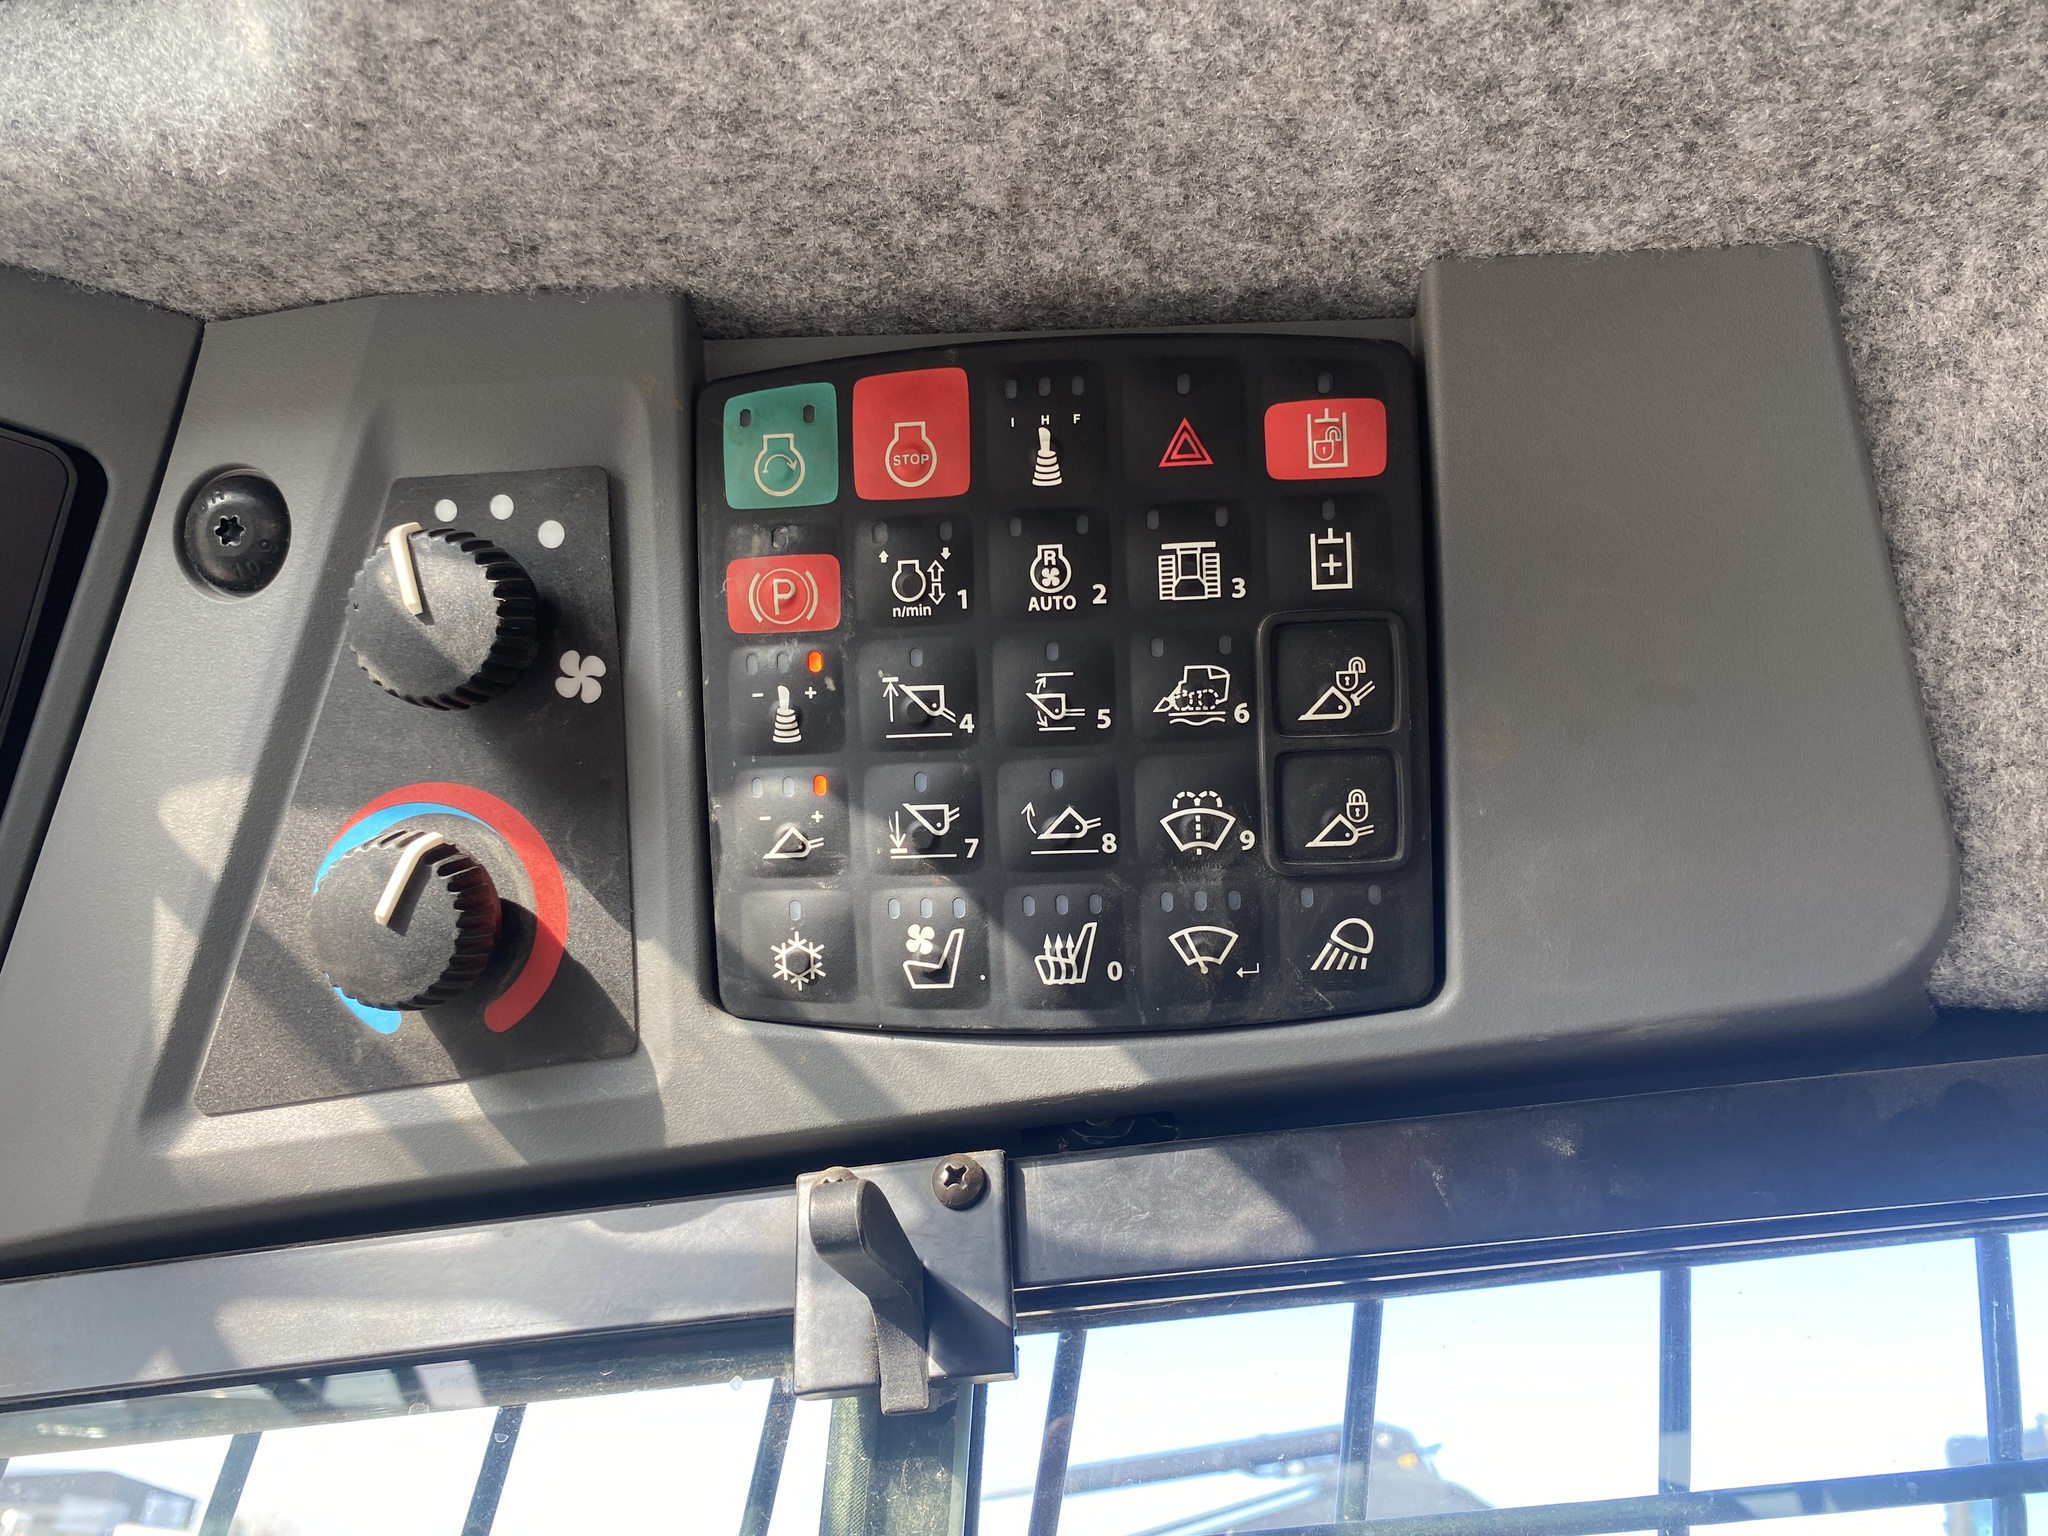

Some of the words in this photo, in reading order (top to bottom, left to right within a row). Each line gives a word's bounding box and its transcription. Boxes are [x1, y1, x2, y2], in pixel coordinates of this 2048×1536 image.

[1041, 415, 1050, 425] H
[1073, 413, 1081, 424] F
[893, 454, 929, 466] STOP
[1044, 550, 1057, 565] R
[772, 578, 796, 615] P
[1092, 584, 1107, 605] 2
[1231, 577, 1246, 598] 3
[957, 589, 968, 610] 1
[1028, 594, 1077, 611] AUTO
[892, 604, 932, 618] n/min
[1096, 708, 1111, 729] 5
[1234, 703, 1250, 723] 6
[958, 714, 975, 734] 4
[963, 838, 979, 858] 7
[1101, 833, 1117, 853] 8
[1239, 830, 1256, 850] 9
[1107, 961, 1123, 981] 0
